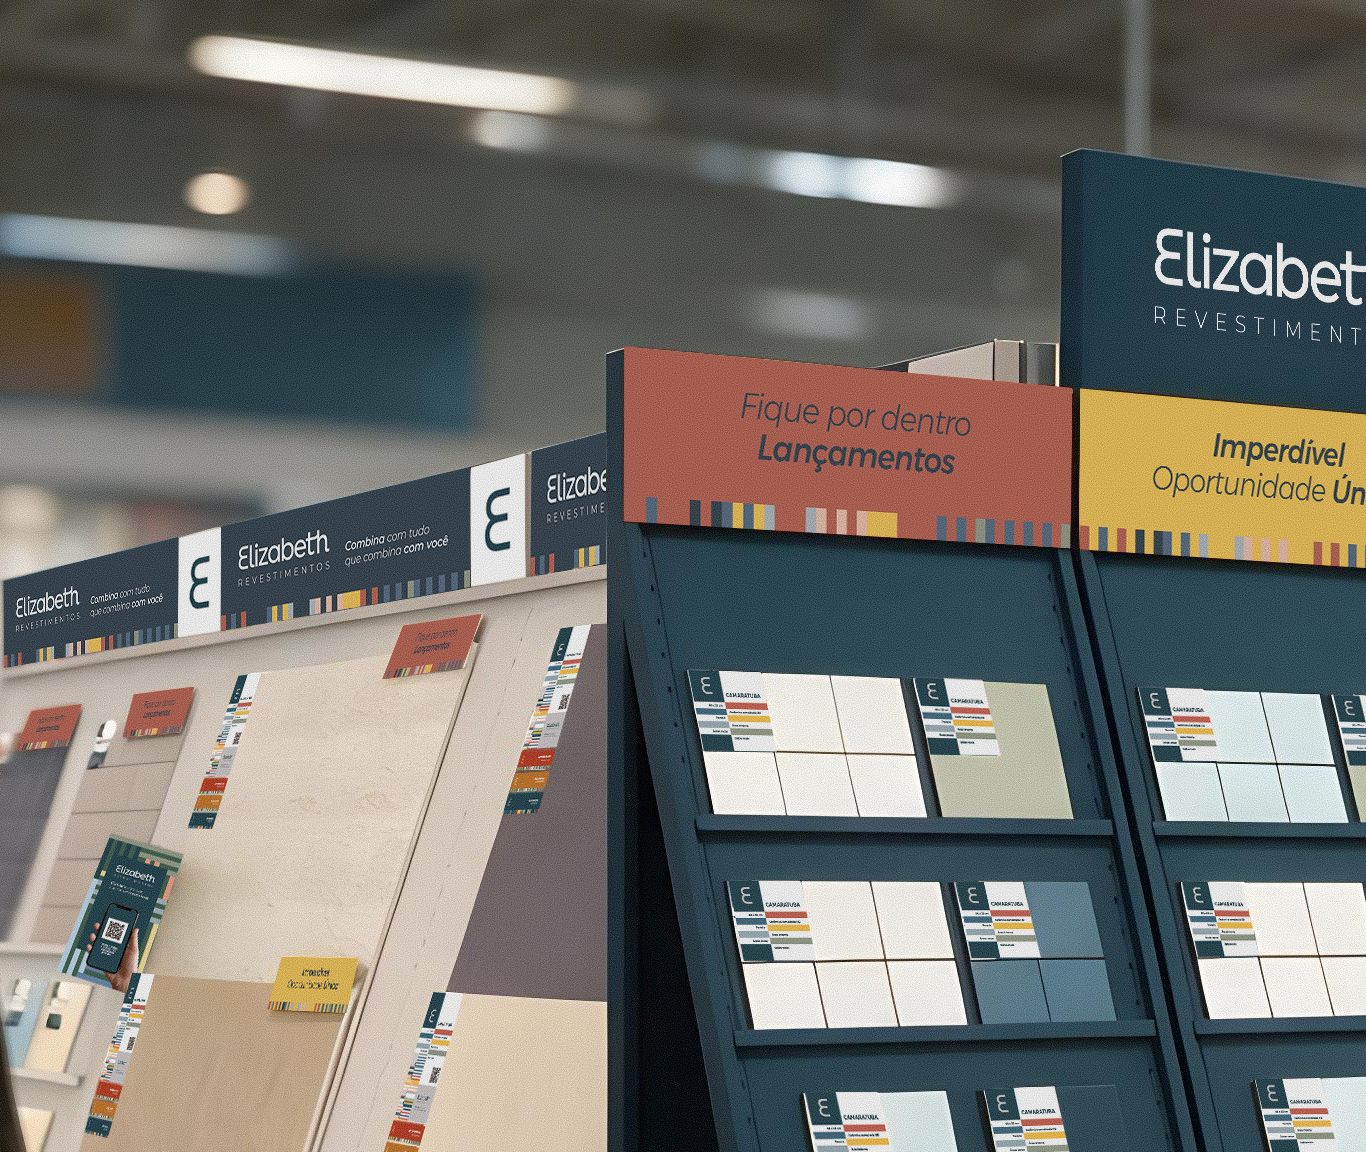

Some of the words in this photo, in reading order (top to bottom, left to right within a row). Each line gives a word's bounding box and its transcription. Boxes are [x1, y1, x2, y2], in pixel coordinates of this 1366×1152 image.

[741, 392, 819, 428] Fique
[826, 405, 876, 432] por
[881, 403, 971, 437] dentro
[757, 433, 956, 475] Lançamentos
[1213, 432, 1346, 468] Imperdível
[546, 465, 607, 504] Elizabe
[1152, 465, 1326, 502] Oportunidade
[546, 502, 605, 524] REVESTIME
[238, 529, 330, 570] Elizabeth
[344, 534, 385, 551] Combina
[386, 532, 407, 543] com
[408, 525, 431, 539] tudo
[344, 554, 362, 568] que
[362, 547, 402, 563] combina
[403, 543, 424, 554] com
[426, 535, 449, 549] você
[237, 560, 331, 588] REVESTIMENTOS
[15, 586, 80, 618] Elizabeth
[90, 591, 119, 605] Combina
[15, 611, 81, 632] REVESTIMENTOS
[115, 864, 156, 884] Elizabeth
